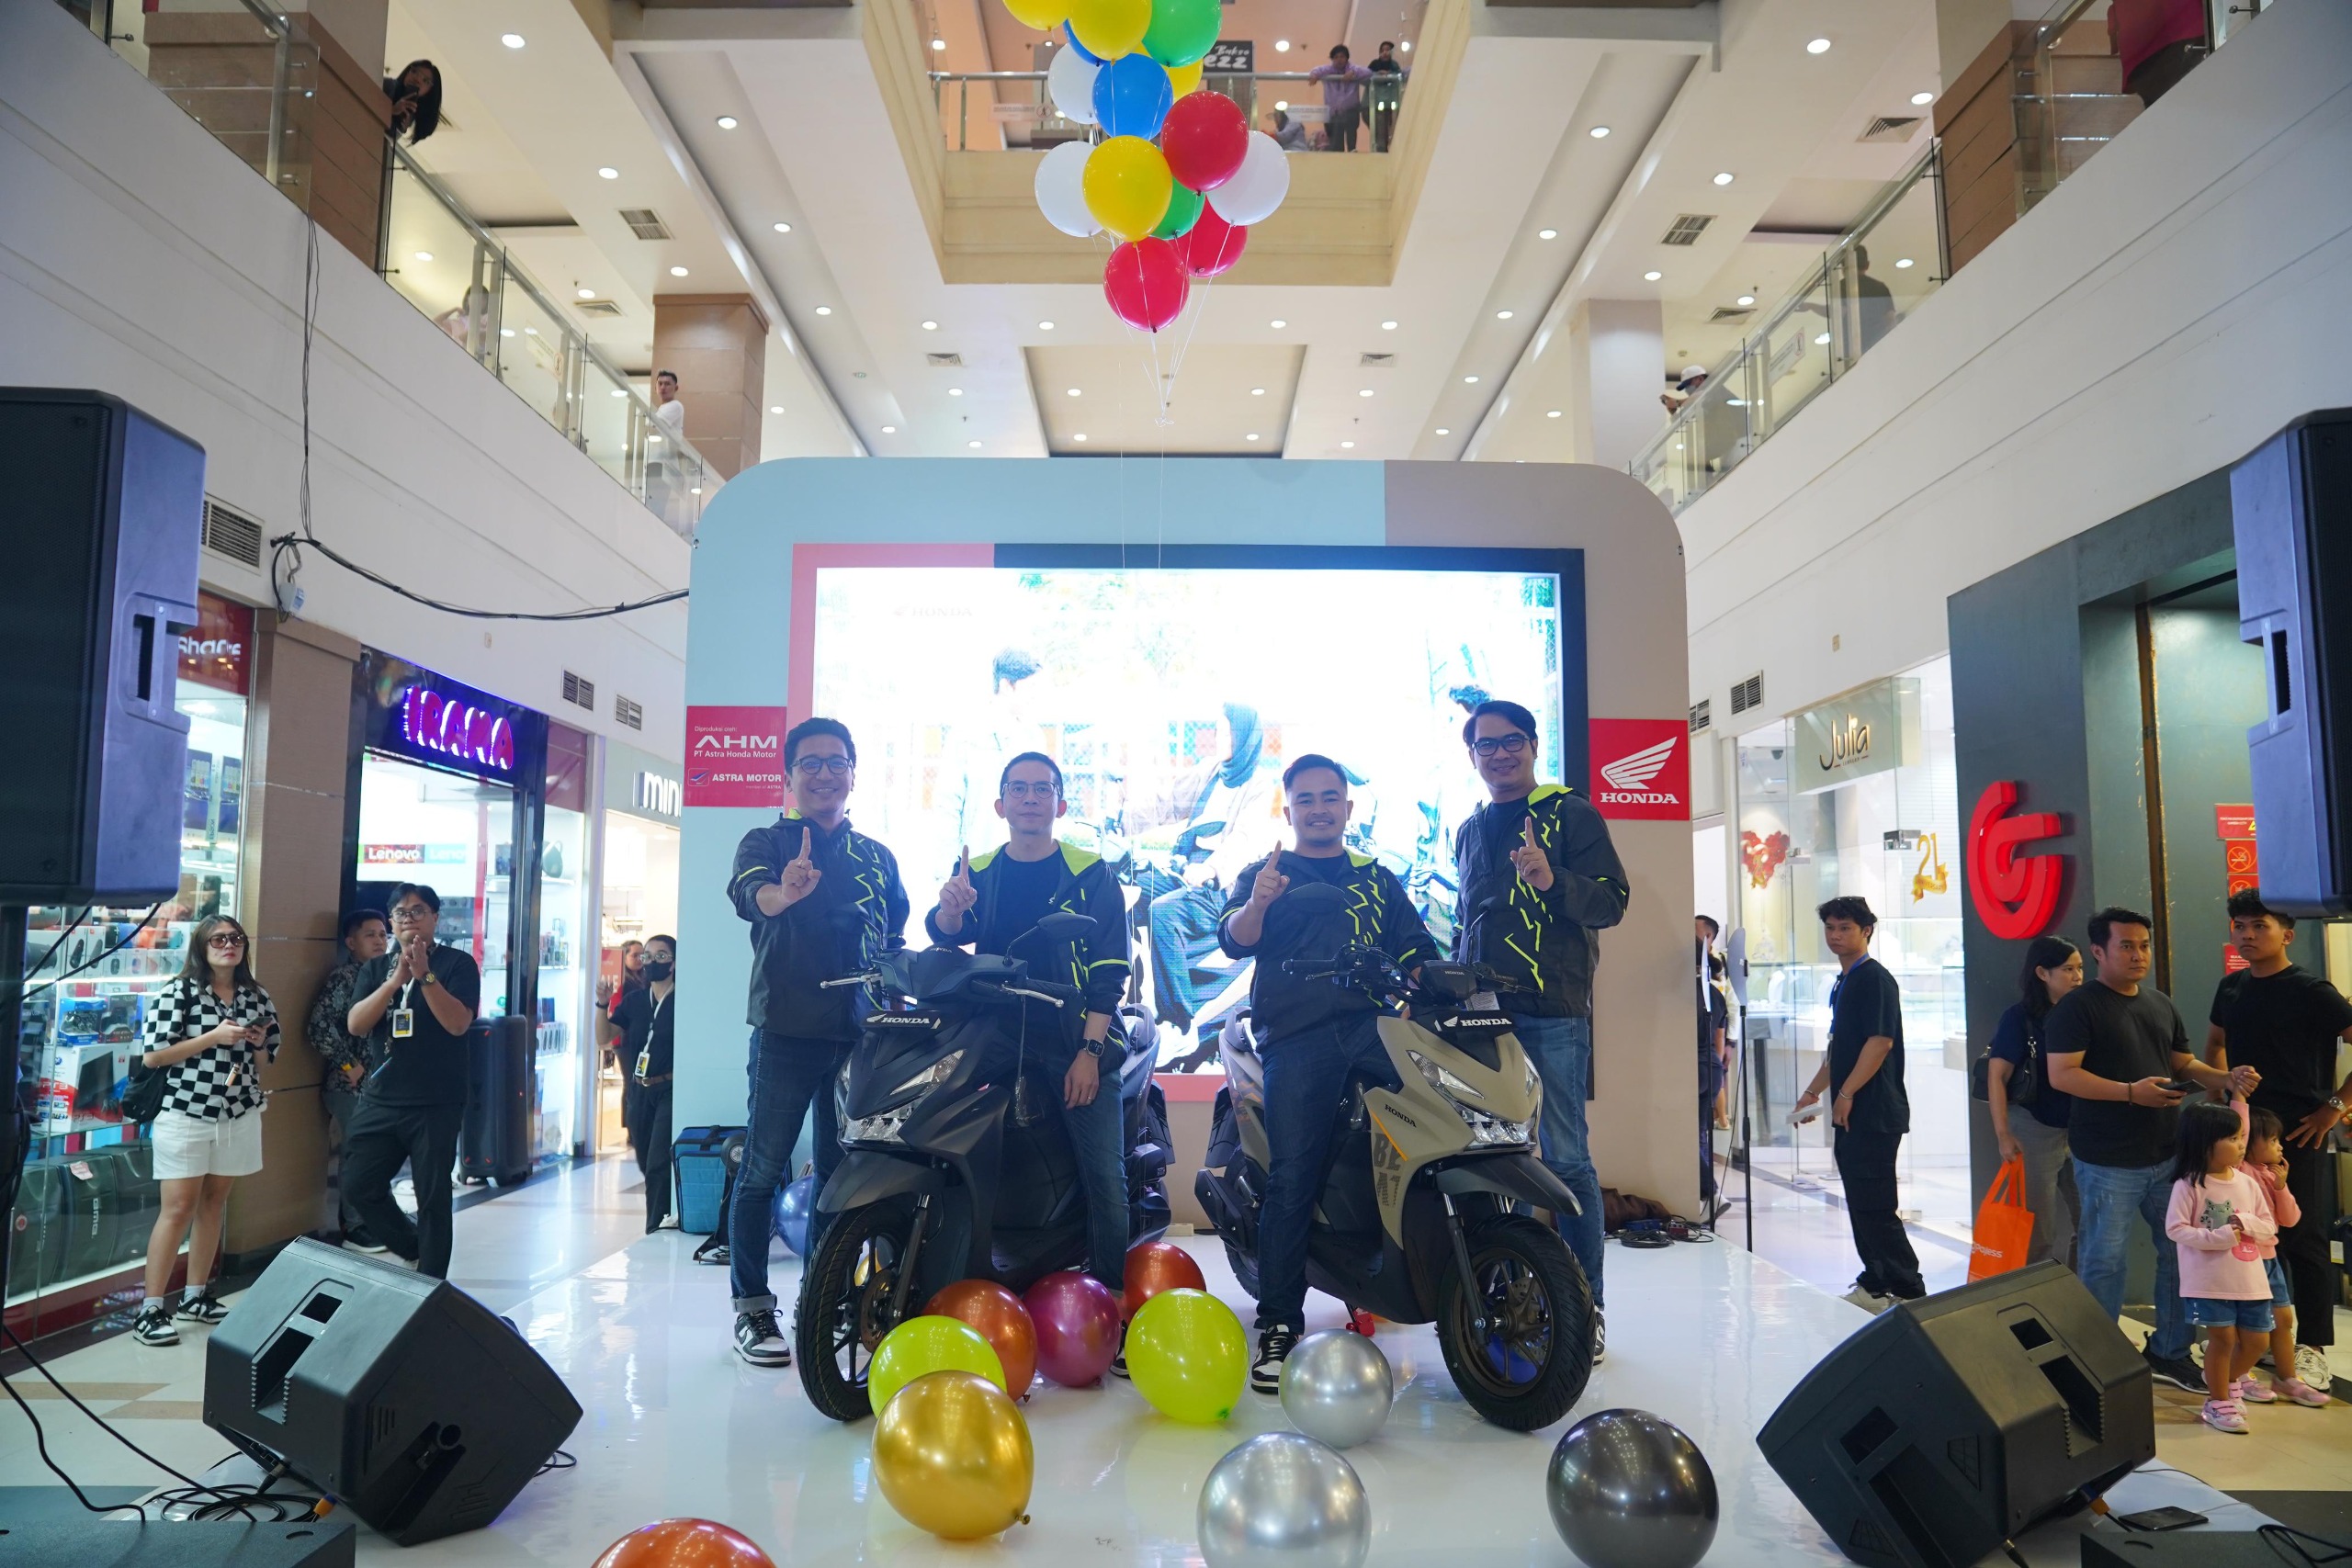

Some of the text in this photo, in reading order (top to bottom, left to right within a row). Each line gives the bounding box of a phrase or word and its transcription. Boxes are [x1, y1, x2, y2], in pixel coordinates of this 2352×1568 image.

[911, 606, 973, 616] HONDA
[402, 685, 514, 770] IRAMA
[695, 735, 777, 749] AHM
[1820, 714, 1871, 771] Julia
[712, 773, 782, 782] ASTRA MOTOR
[1600, 792, 1679, 804] HONDA
[368, 847, 421, 860] Lenovo
[1460, 1018, 1512, 1027] HONDA
[1384, 1103, 1417, 1128] HONDA
